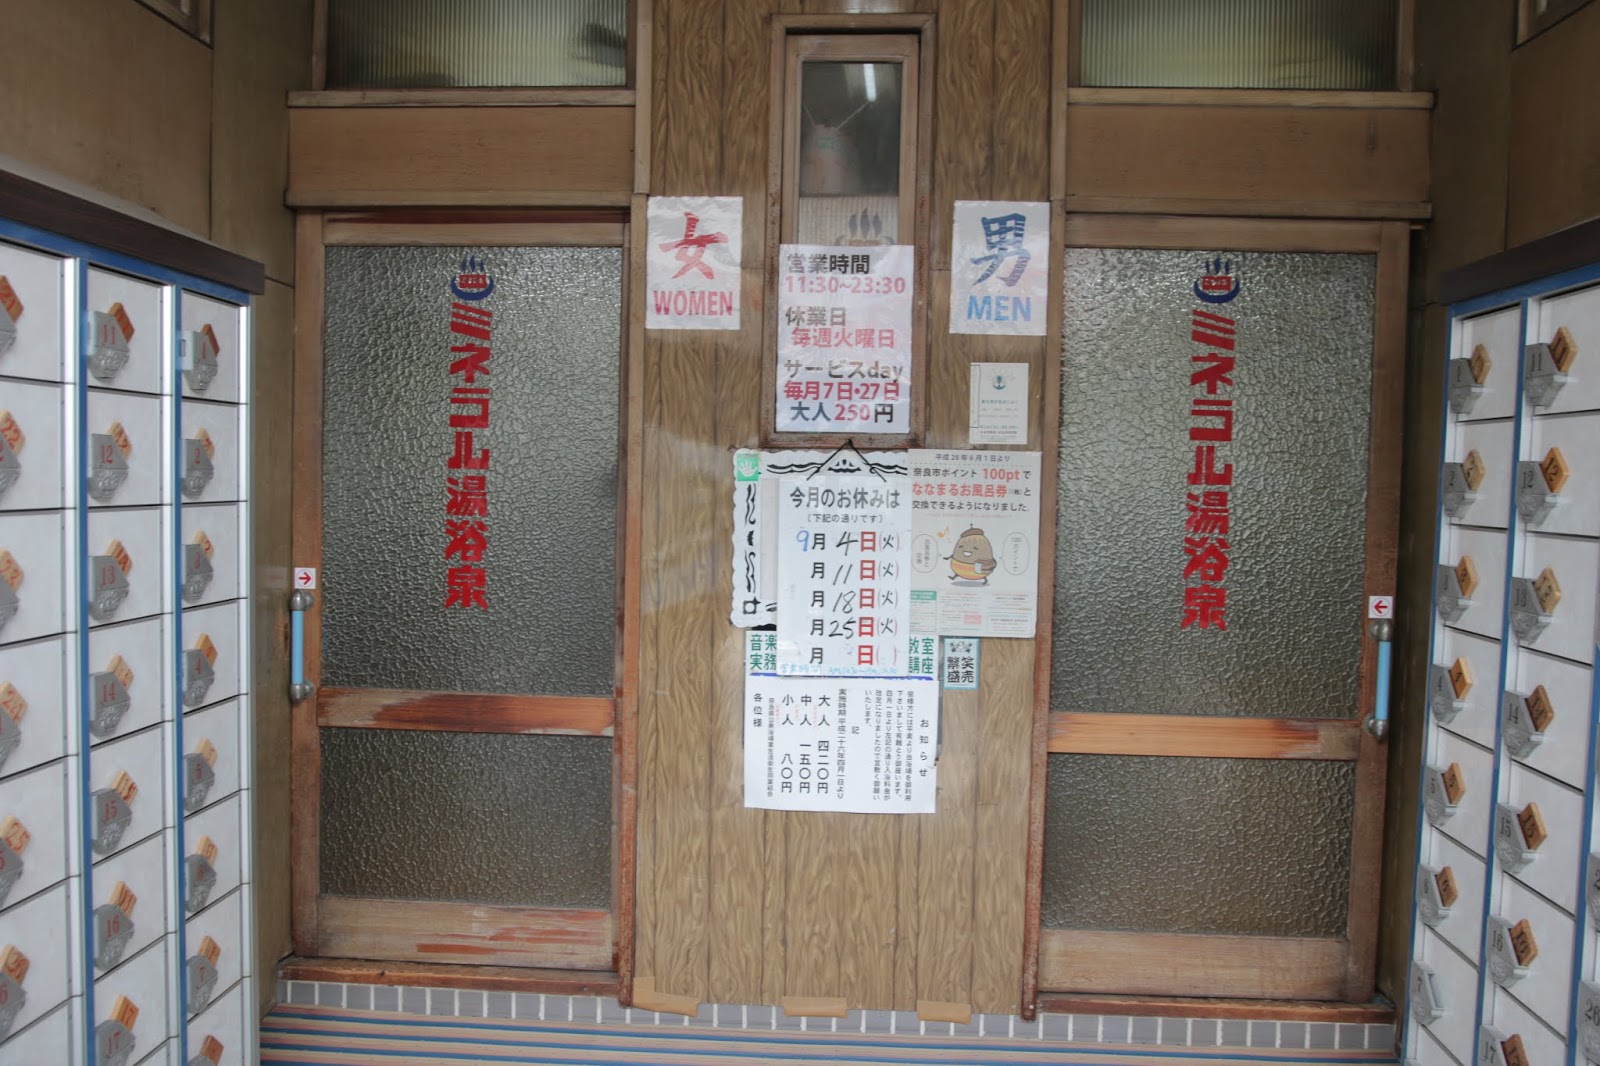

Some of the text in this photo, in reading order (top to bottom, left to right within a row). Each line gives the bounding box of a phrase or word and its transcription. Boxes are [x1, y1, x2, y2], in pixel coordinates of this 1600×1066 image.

[658, 211, 729, 280] 女
[970, 212, 1031, 287] 男
[786, 253, 870, 274] 営業時間
[653, 290, 733, 316] WOMEN
[966, 295, 1031, 321] MEN
[785, 306, 847, 327] 休業日
[103, 324, 116, 345] 11
[791, 327, 895, 349] 毎週火曜日
[784, 359, 904, 382] サービスday
[1530, 353, 1543, 372] 11
[790, 401, 894, 423] 大人250円
[100, 445, 114, 464] 12
[194, 448, 201, 464] 2
[935, 453, 1010, 463] 平成28年6月1日より
[913, 467, 978, 478] 奈良市ポイント
[1522, 470, 1534, 491] 12
[789, 486, 900, 509] 今月のお休みは
[912, 500, 1030, 512] 交換できるようになりました。
[102, 565, 116, 586] 13
[810, 562, 825, 579] 月
[810, 590, 825, 608] 月
[1515, 587, 1527, 608] 13
[810, 618, 824, 636] 月
[809, 647, 824, 664] 月
[103, 682, 116, 702] 14
[838, 688, 847, 717] 実施時期
[753, 693, 763, 728] 各位様
[781, 694, 794, 726] 小人
[800, 694, 812, 726] 中人
[818, 694, 831, 726] 大人
[1508, 702, 1520, 725] 14
[851, 726, 860, 735] 記
[919, 719, 929, 777] お知らせ
[105, 799, 118, 821] 15
[1501, 816, 1512, 838] 15
[107, 914, 120, 938] 16
[1491, 930, 1503, 952] 16
[108, 1029, 121, 1057] 17
[1484, 1041, 1497, 1064] 17
